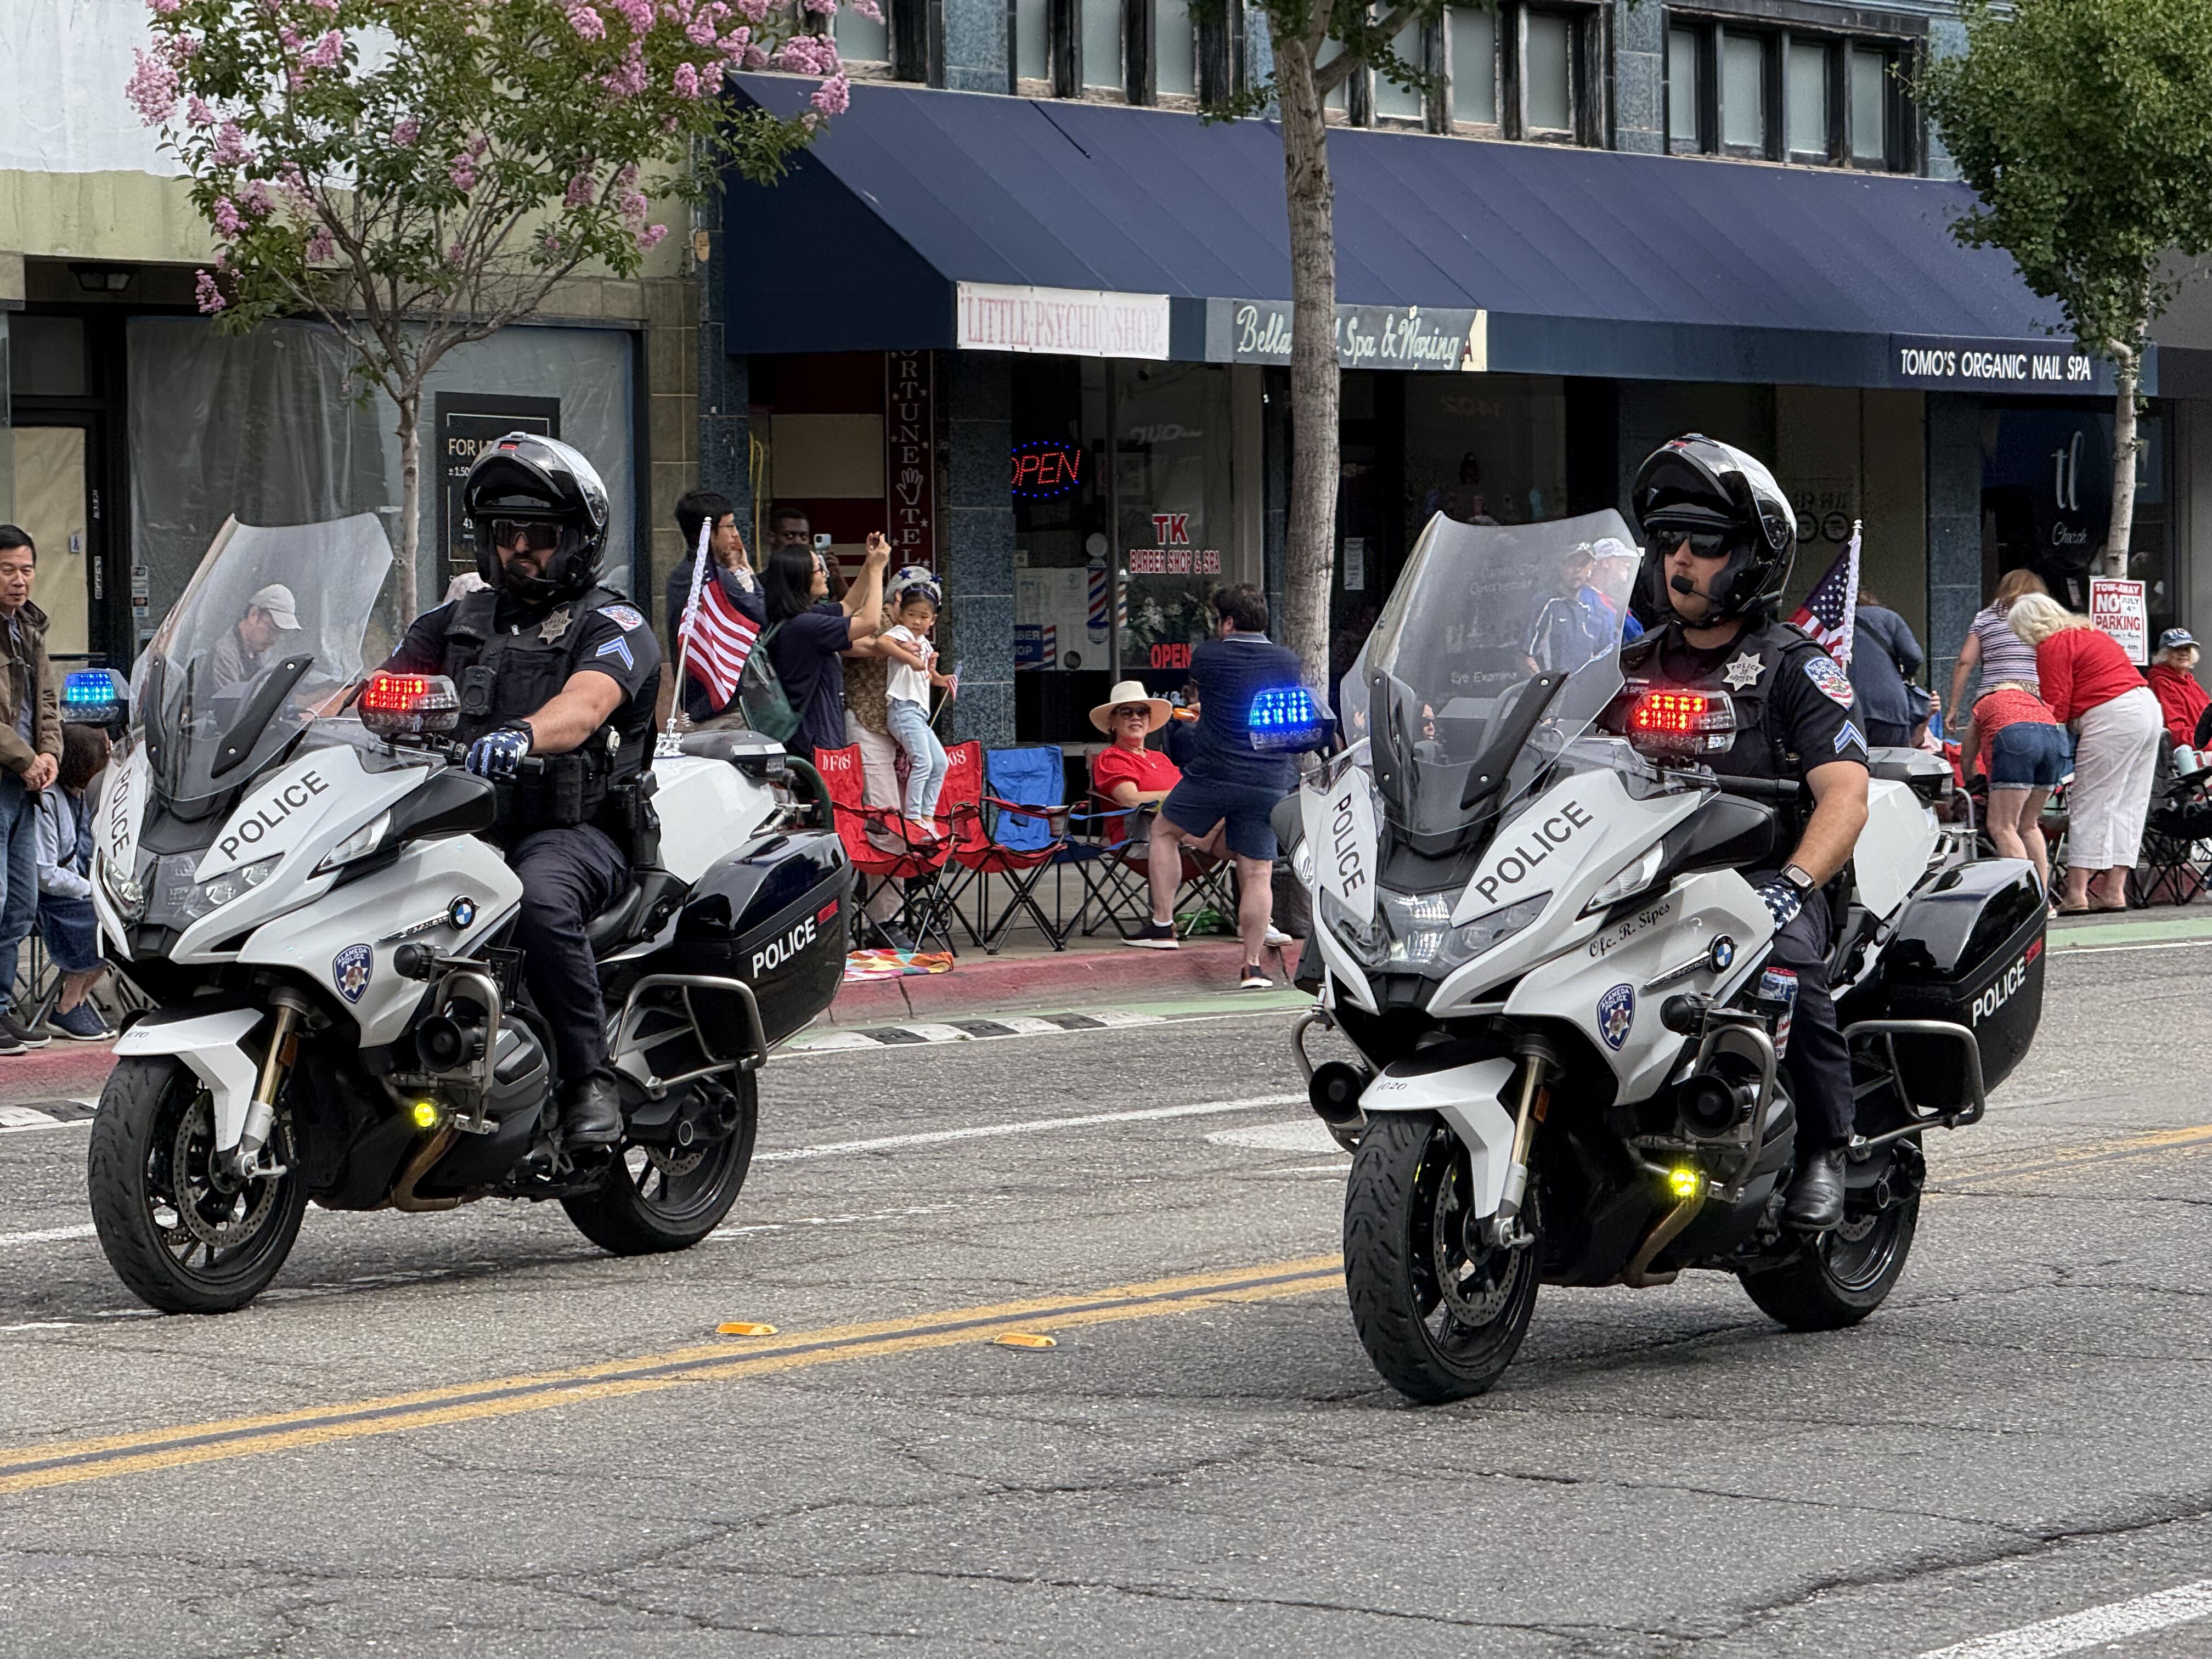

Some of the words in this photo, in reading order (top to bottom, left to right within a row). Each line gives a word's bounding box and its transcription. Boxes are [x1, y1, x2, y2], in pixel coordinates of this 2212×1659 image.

[967, 295, 1030, 346] LITTLE
[1035, 301, 1110, 349] PSYCHIC
[1343, 317, 1376, 365] Spa
[1380, 314, 1397, 358] &
[1901, 349, 1955, 377] TOMO'S
[1962, 351, 2027, 380] ORGANIC
[2032, 354, 2062, 381] NAIL
[2067, 355, 2091, 381] SPA
[899, 350, 922, 464] RTUNE
[448, 438, 476, 456] FOR
[1152, 513, 1189, 545] TK
[1130, 549, 1166, 574] BARBER
[1167, 550, 1192, 574] SHOP
[1194, 550, 1201, 574] &
[1203, 550, 1221, 574] SPA
[2095, 583, 2140, 594] TOW-AWAY
[2096, 594, 2120, 613] NO
[2121, 597, 2140, 605] JULY
[2096, 615, 2141, 631] PARKING
[1150, 642, 1192, 669] OPEN
[109, 768, 132, 858] POLICE
[218, 770, 330, 862] POLICE
[1333, 792, 1366, 899] POLICE
[1474, 800, 1594, 905] POLICE
[1589, 938, 1616, 958] Ofc.
[1619, 923, 1635, 941] R.
[1639, 902, 1671, 929] Sipes
[337, 947, 369, 964] ALAMEDA
[341, 953, 365, 969] POLICE
[752, 915, 817, 979] POLICE
[1601, 987, 1630, 1009] ALAMEDA
[1604, 995, 1628, 1014] POLICE
[1972, 956, 2025, 1028] POLICE
[1375, 1082, 1408, 1092] 1020
